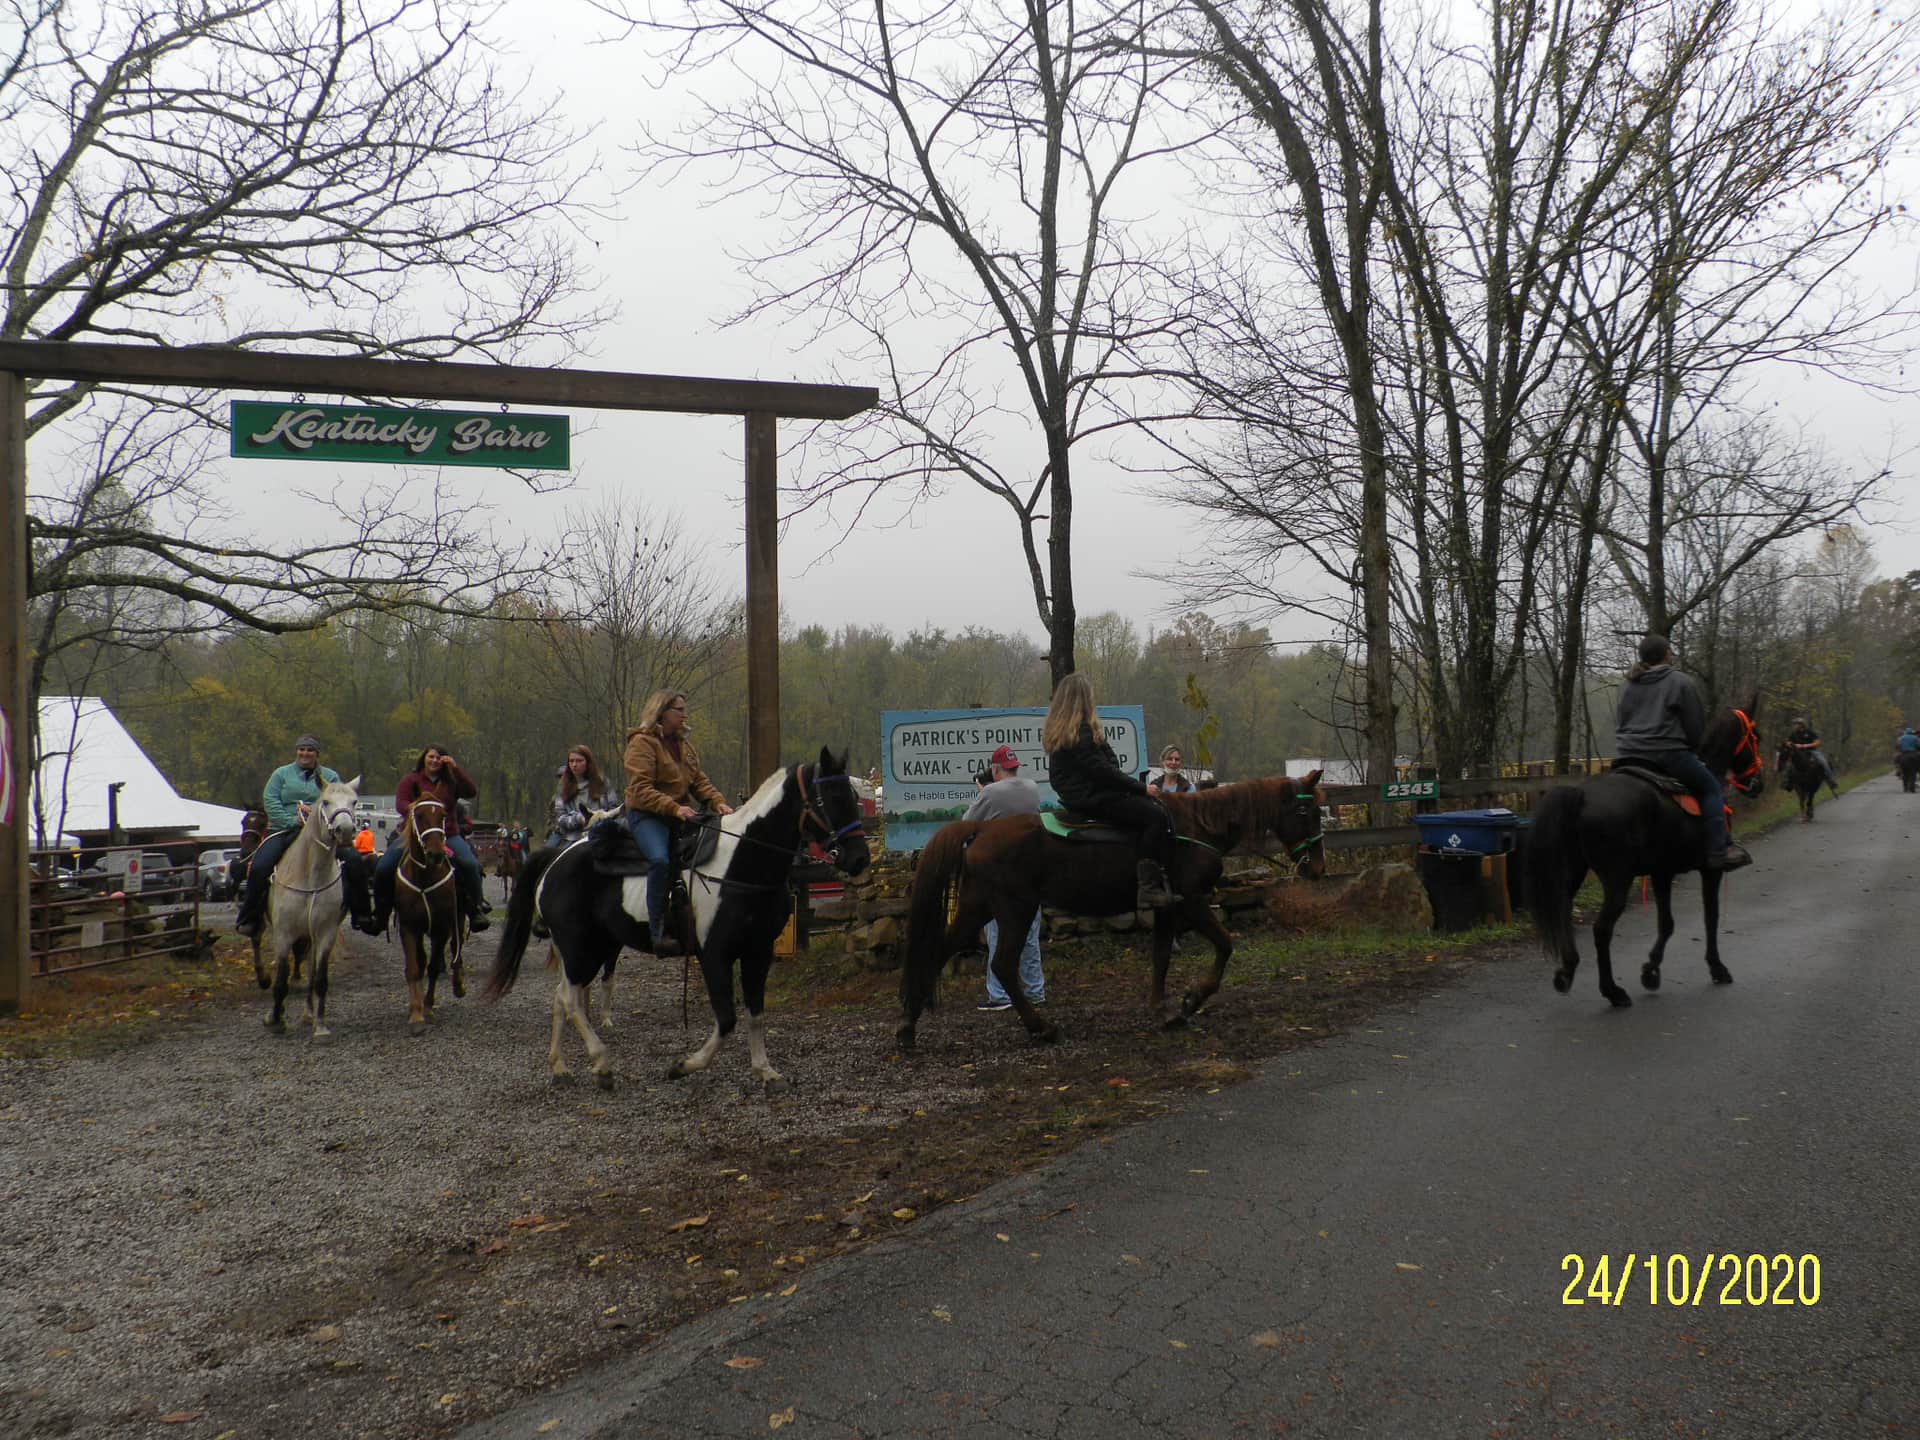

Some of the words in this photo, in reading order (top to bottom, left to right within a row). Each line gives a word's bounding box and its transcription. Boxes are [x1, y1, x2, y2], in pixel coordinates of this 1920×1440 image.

[252, 409, 439, 453] Kentucky
[451, 418, 551, 452] Barn
[902, 729, 980, 747] PATRICK'S
[985, 728, 1032, 744] POINT
[903, 759, 951, 776] KAYAK
[904, 791, 917, 800] Se
[1387, 783, 1434, 797] 2343
